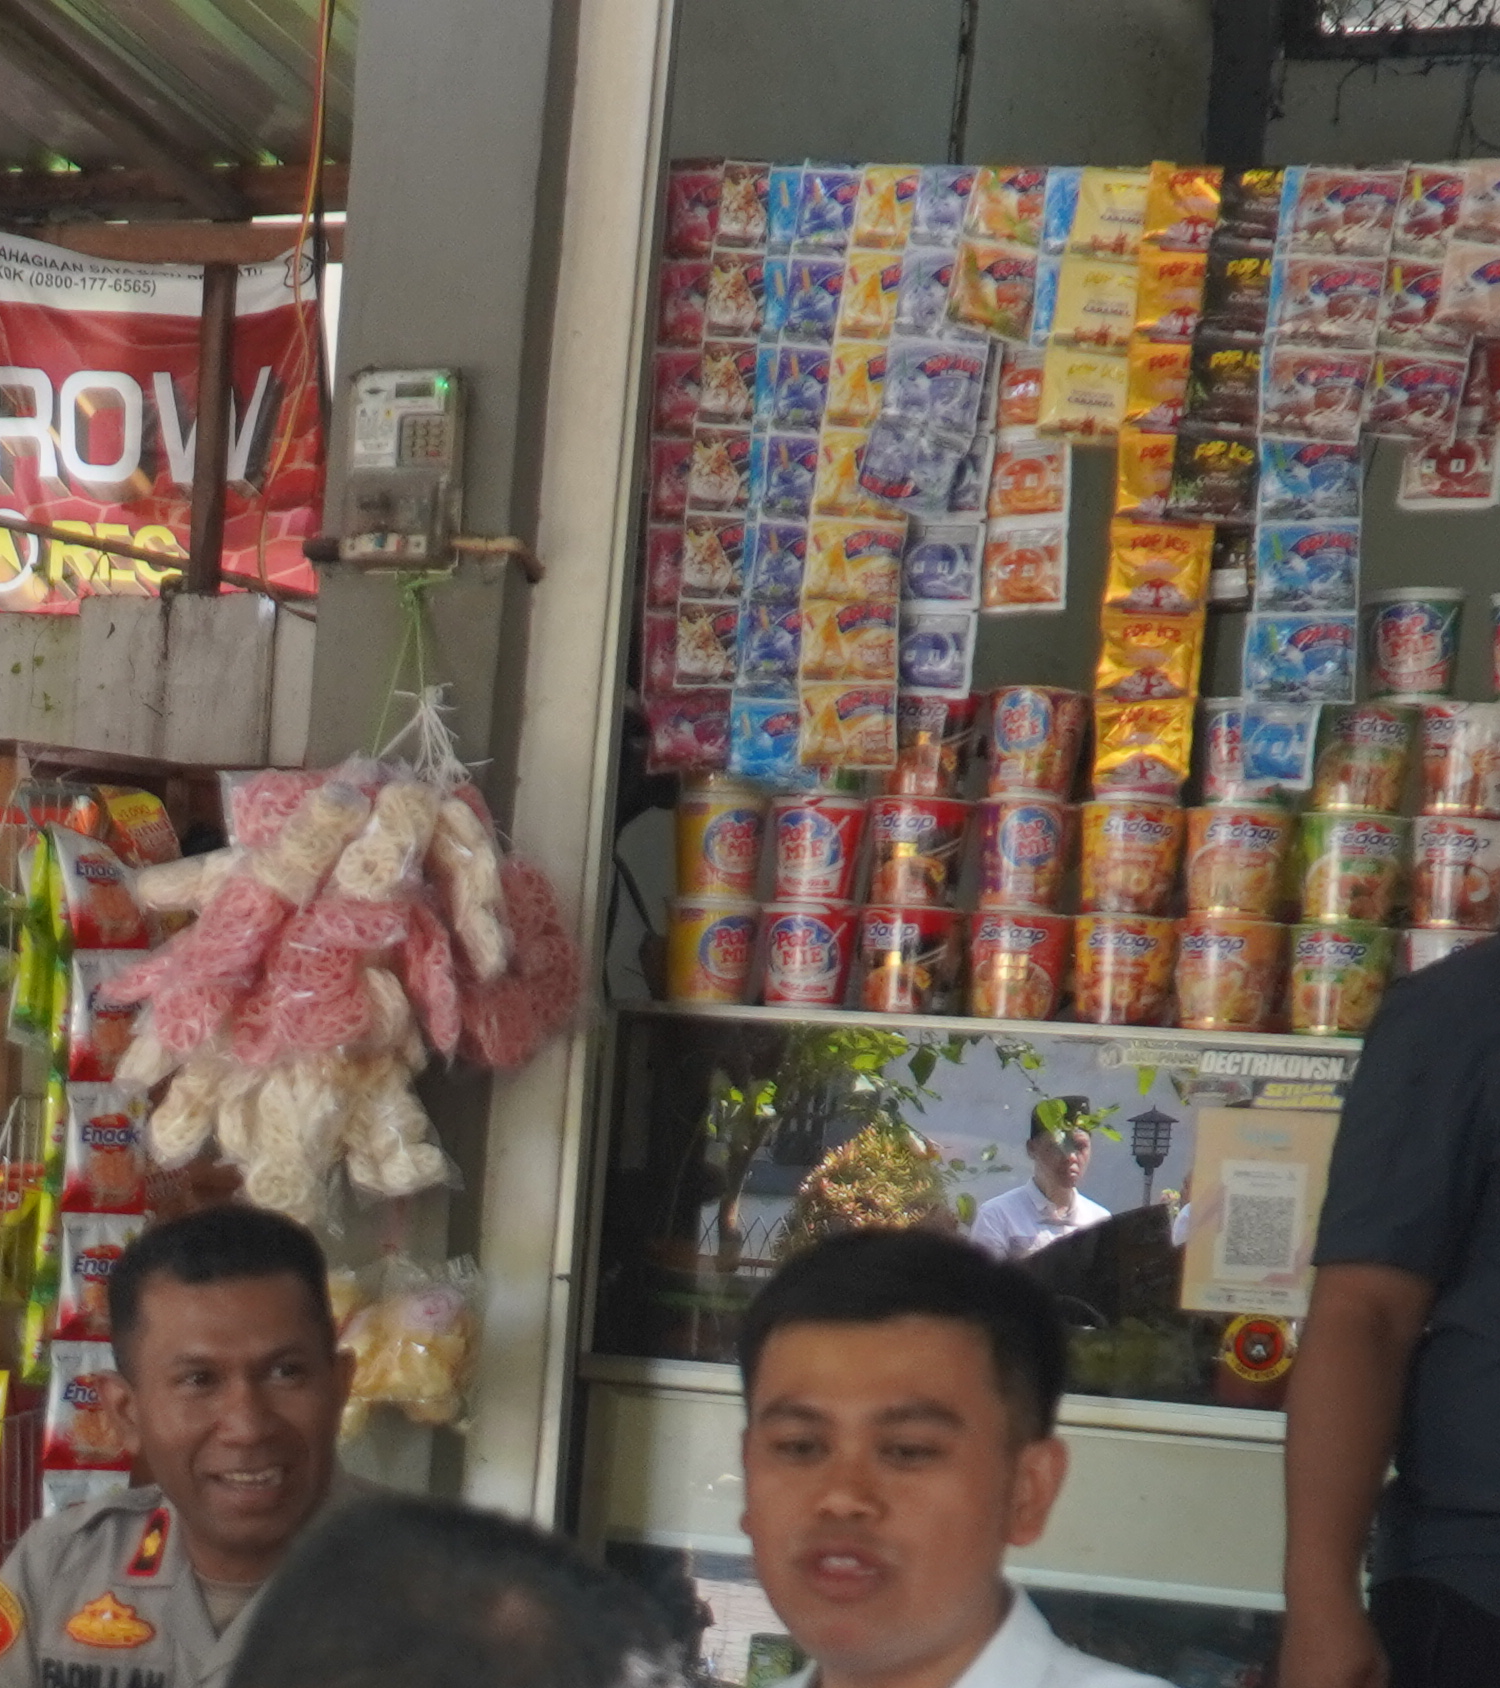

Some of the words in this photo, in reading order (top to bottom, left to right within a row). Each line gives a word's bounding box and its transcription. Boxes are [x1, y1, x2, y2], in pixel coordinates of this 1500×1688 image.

[28, 271, 157, 297] (0800-177-6565)
[773, 927, 812, 950] POP
[978, 924, 1048, 946] Sedaap
[780, 945, 824, 969] MIE
